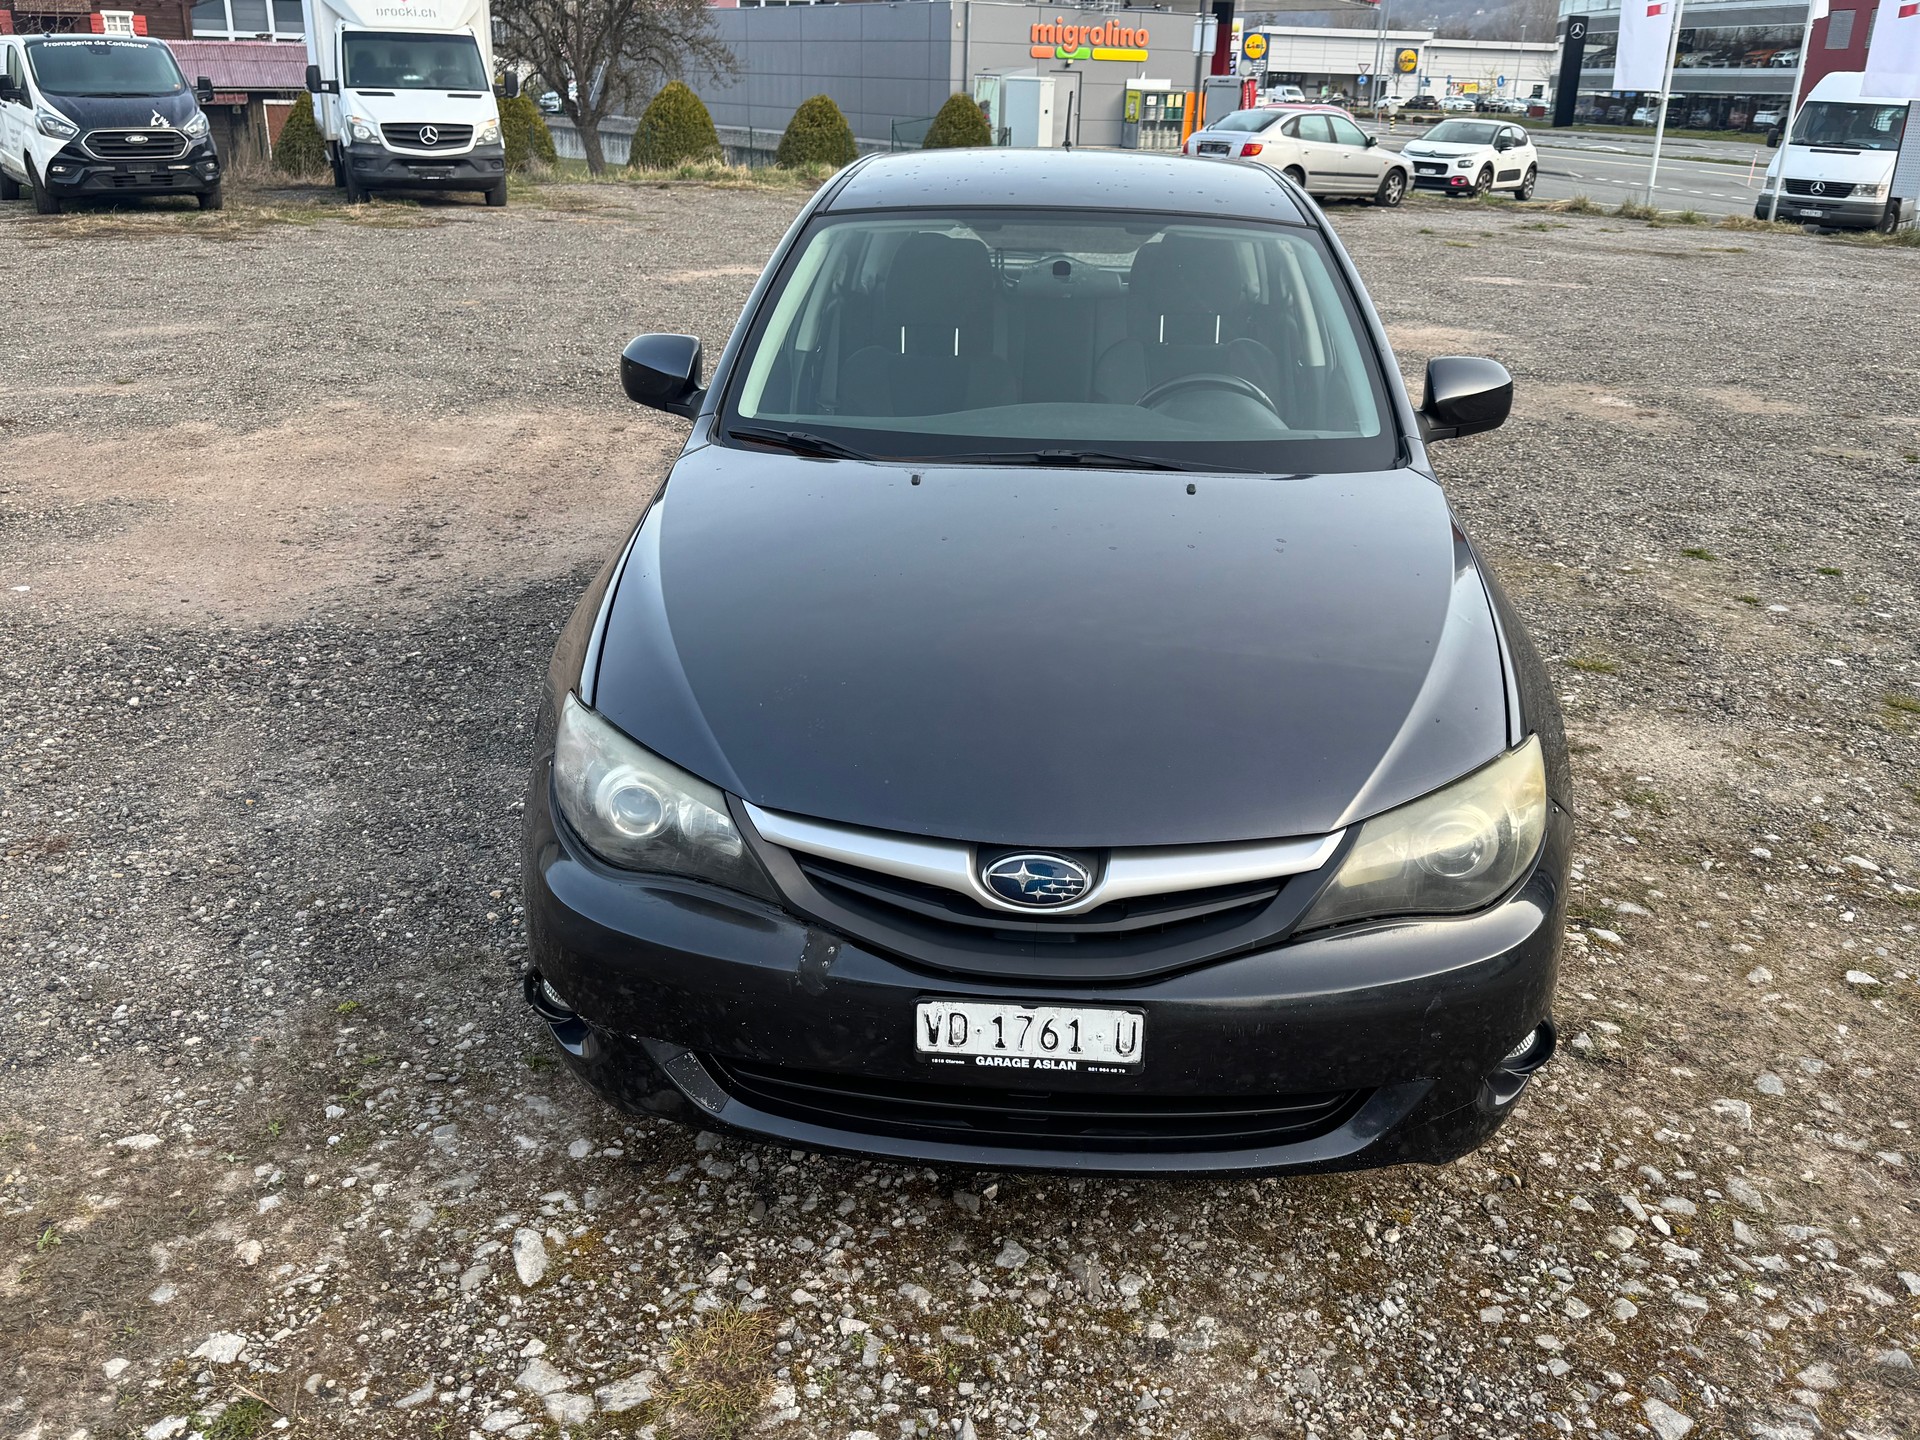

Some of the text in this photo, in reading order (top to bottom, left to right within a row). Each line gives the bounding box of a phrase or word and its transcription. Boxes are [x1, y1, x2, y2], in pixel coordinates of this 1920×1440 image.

[43, 40, 93, 48] Fromagerie
[1031, 16, 1150, 53] migrolino
[925, 1011, 1137, 1055] VD 1761 U
[975, 1056, 1077, 1071] GARAGE ASLAN
